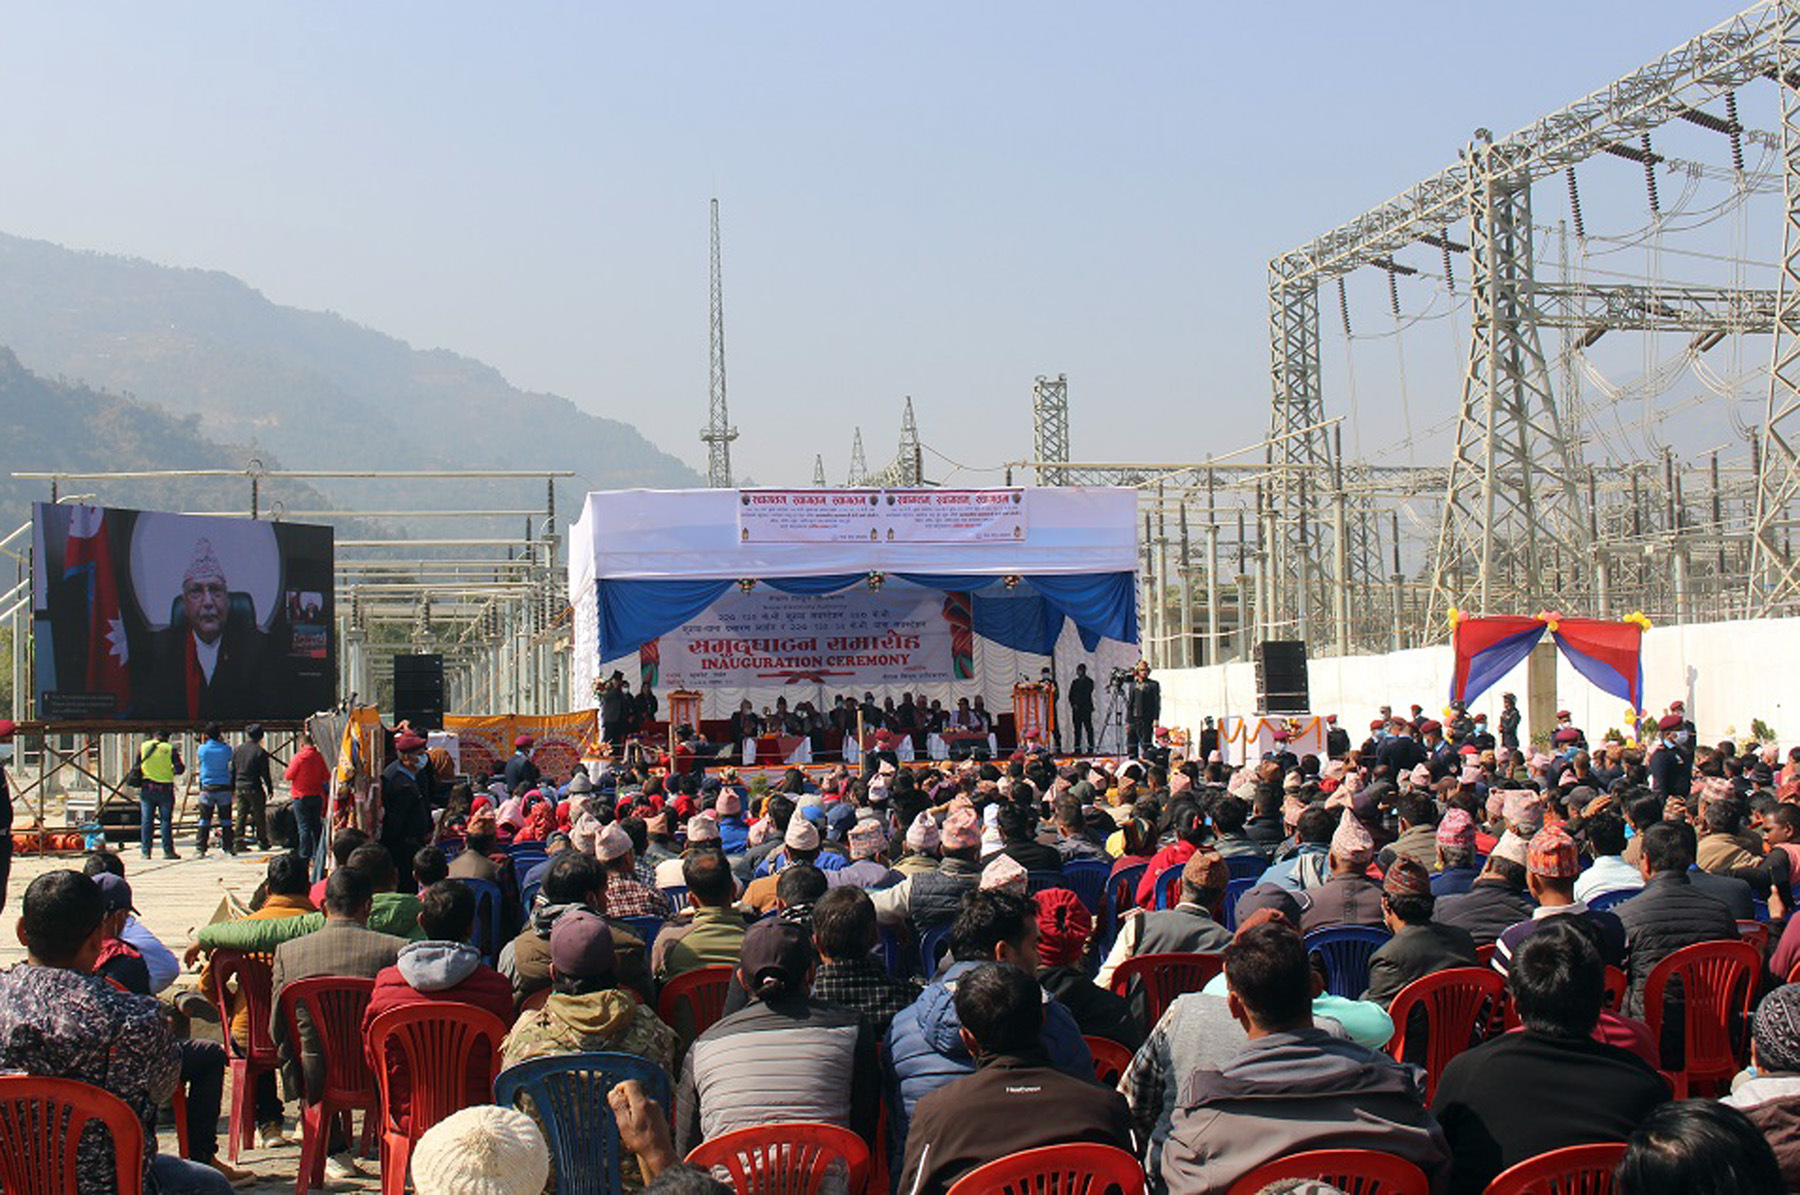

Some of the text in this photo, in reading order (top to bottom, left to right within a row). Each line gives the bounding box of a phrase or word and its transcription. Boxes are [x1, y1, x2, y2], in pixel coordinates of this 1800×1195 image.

[827, 629, 921, 651] समारोह
[701, 654, 911, 670] INAUGURATION CEREMONY
